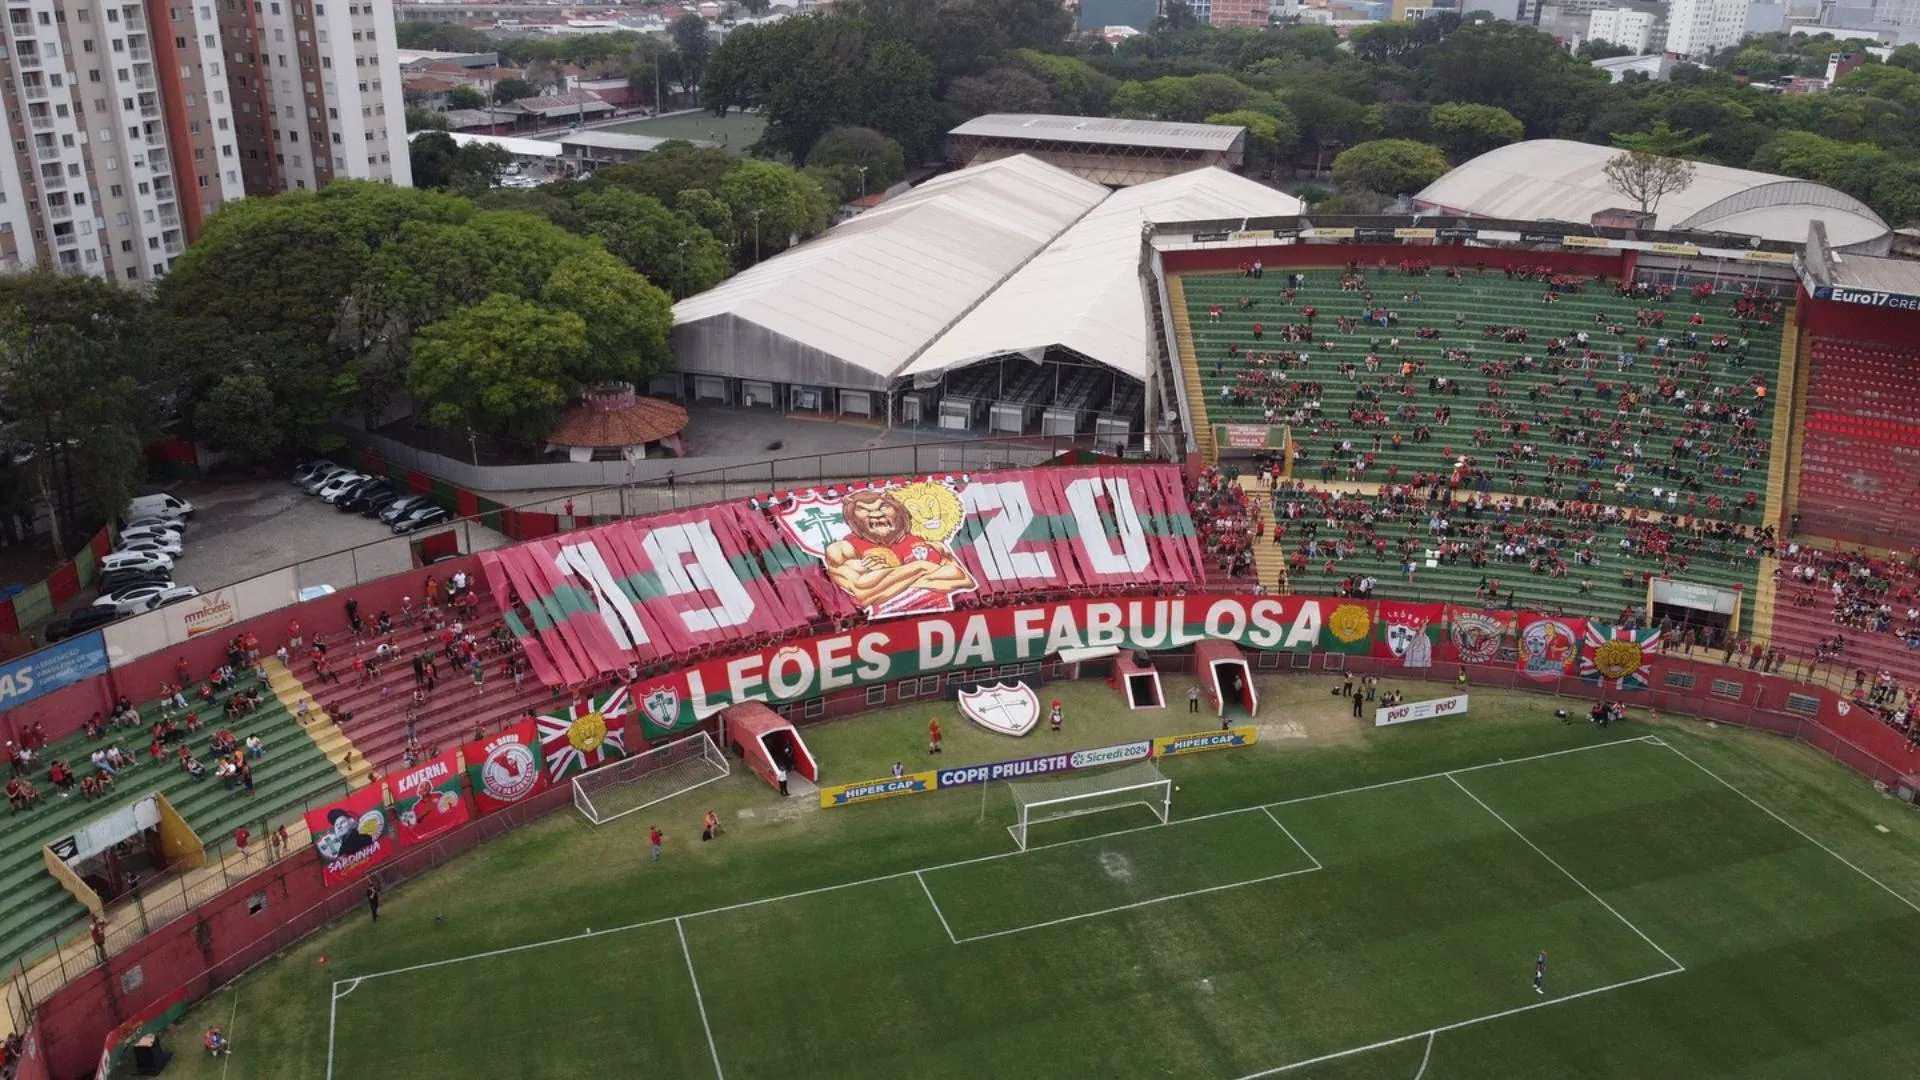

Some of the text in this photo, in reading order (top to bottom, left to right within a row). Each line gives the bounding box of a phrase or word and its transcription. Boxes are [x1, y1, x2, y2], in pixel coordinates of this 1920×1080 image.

[1831, 288, 1890, 306] Euro17
[686, 598, 1322, 720] LEÕES DA FABULOSA
[496, 733, 520, 746] DAVID
[1174, 738, 1209, 749] HIPER
[1211, 734, 1235, 744] CAP
[398, 761, 448, 793] KAVERNA
[941, 745, 1148, 786] COPA PAULISTA Sicredi 2024
[846, 786, 884, 798] HIPER
[888, 780, 914, 791] CAP
[328, 840, 381, 874] SARDINHA
